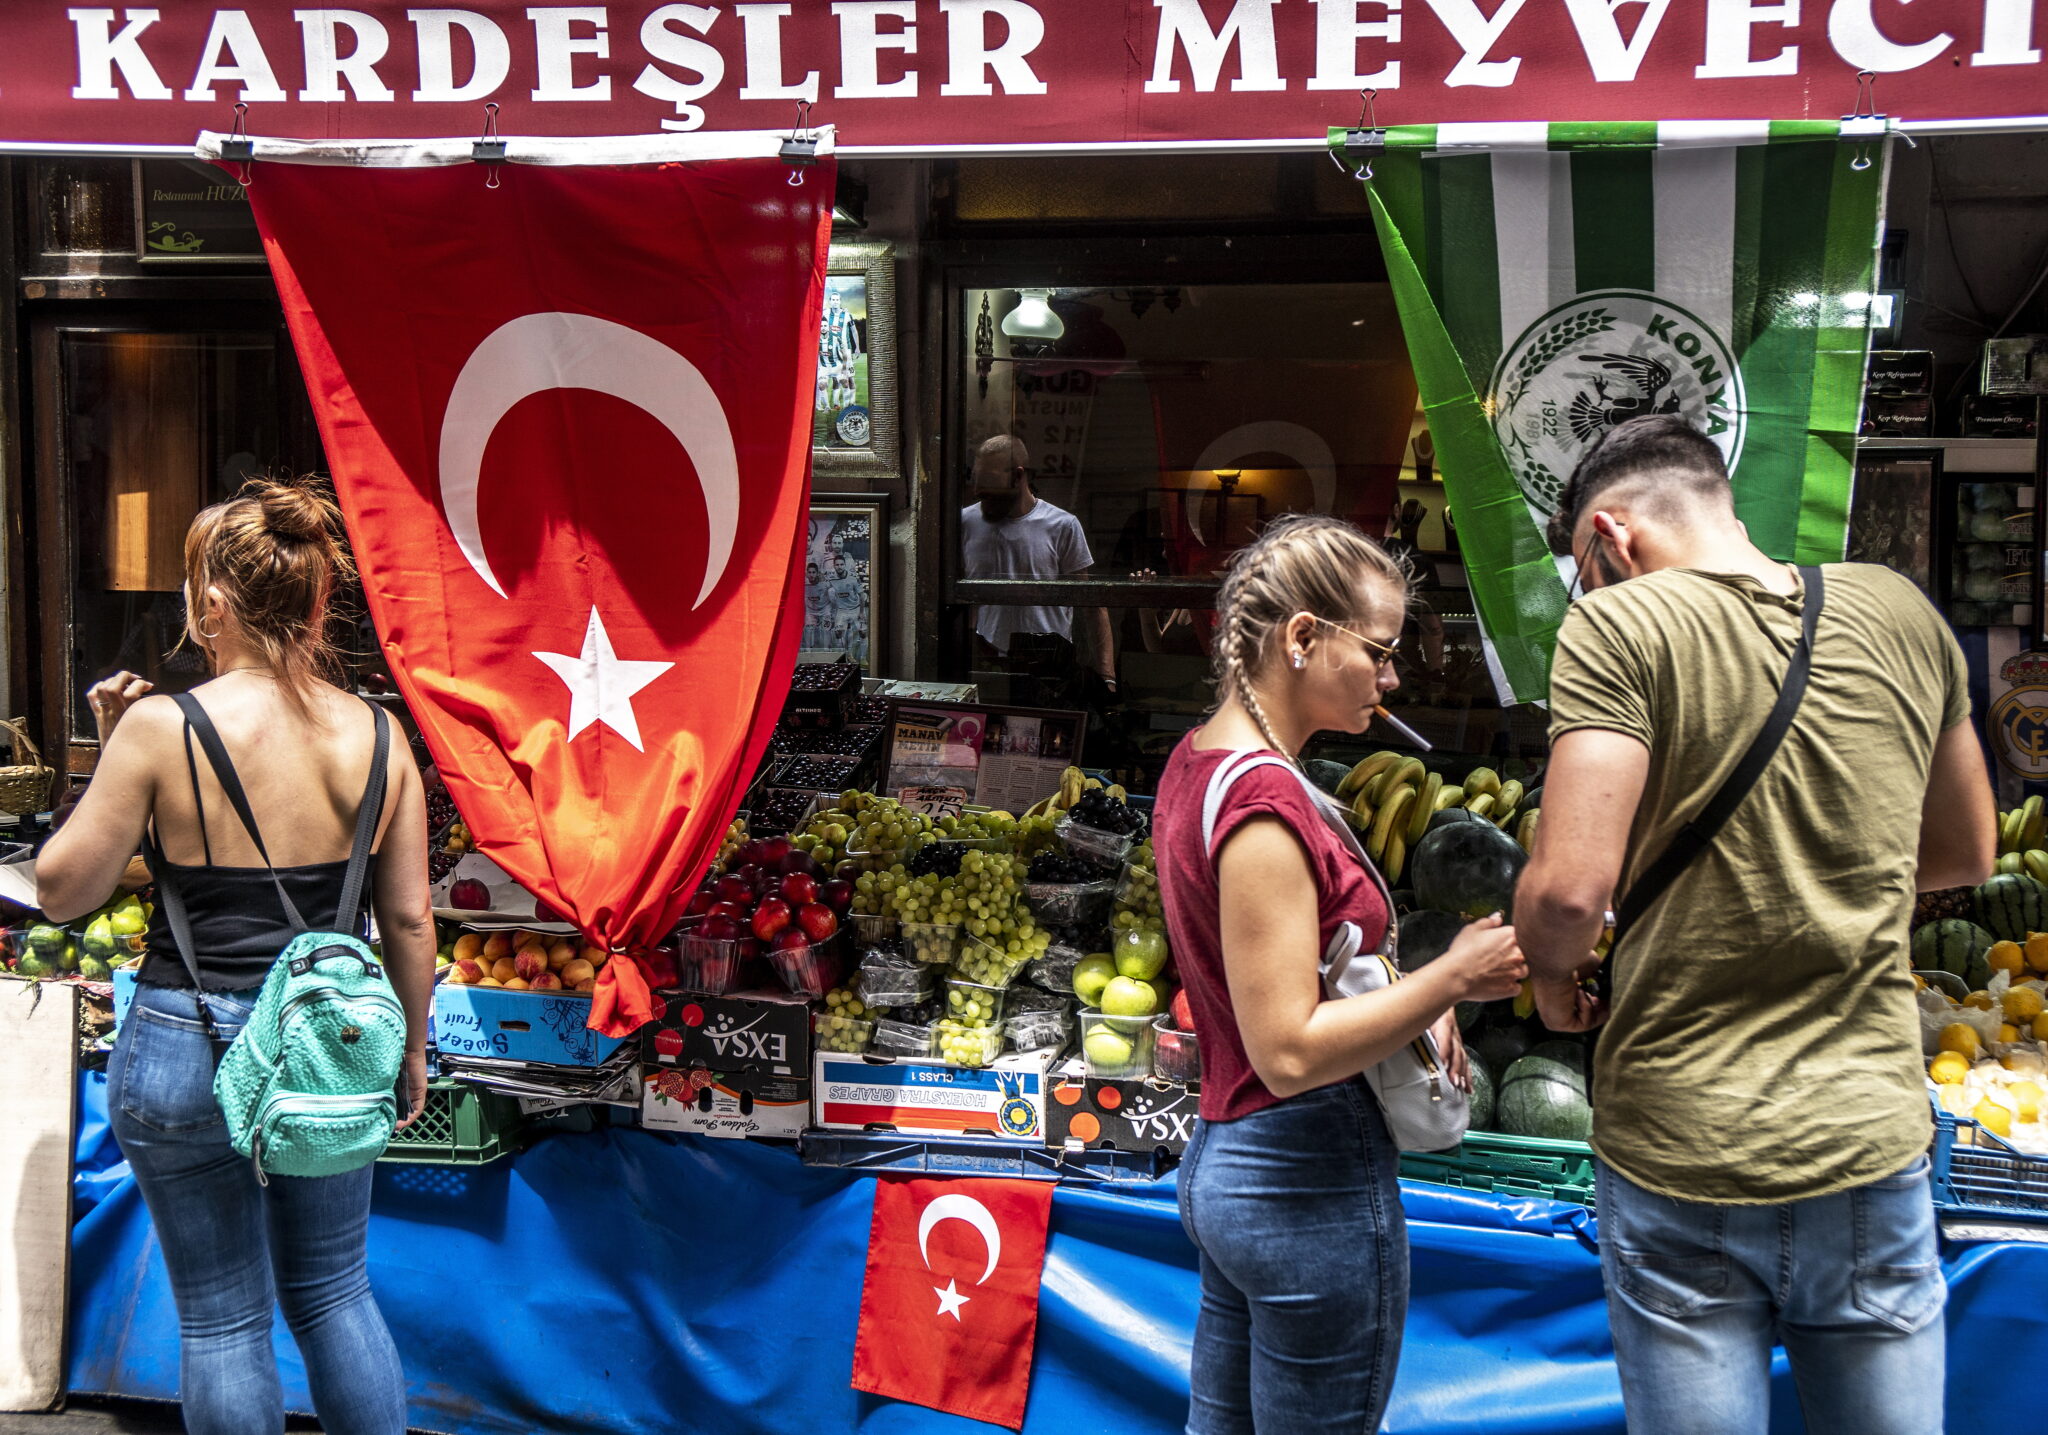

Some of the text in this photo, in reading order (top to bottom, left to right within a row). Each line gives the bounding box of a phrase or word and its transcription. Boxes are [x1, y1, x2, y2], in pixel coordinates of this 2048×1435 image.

[66, 1, 1048, 131] KARDEŞLER
[152, 189, 203, 201] Restaurant
[1647, 314, 1729, 436] KONYA
[1541, 399, 1557, 437] 1922
[898, 729, 945, 740] MANAV
[444, 1012, 482, 1032] Fruit
[439, 1032, 508, 1054] Sweet
[707, 1025, 786, 1062] EXSA
[910, 1071, 954, 1083] CLASS 1
[828, 1086, 987, 1108] HOEKSTRA GRAPES
[719, 1119, 760, 1133] Golden
